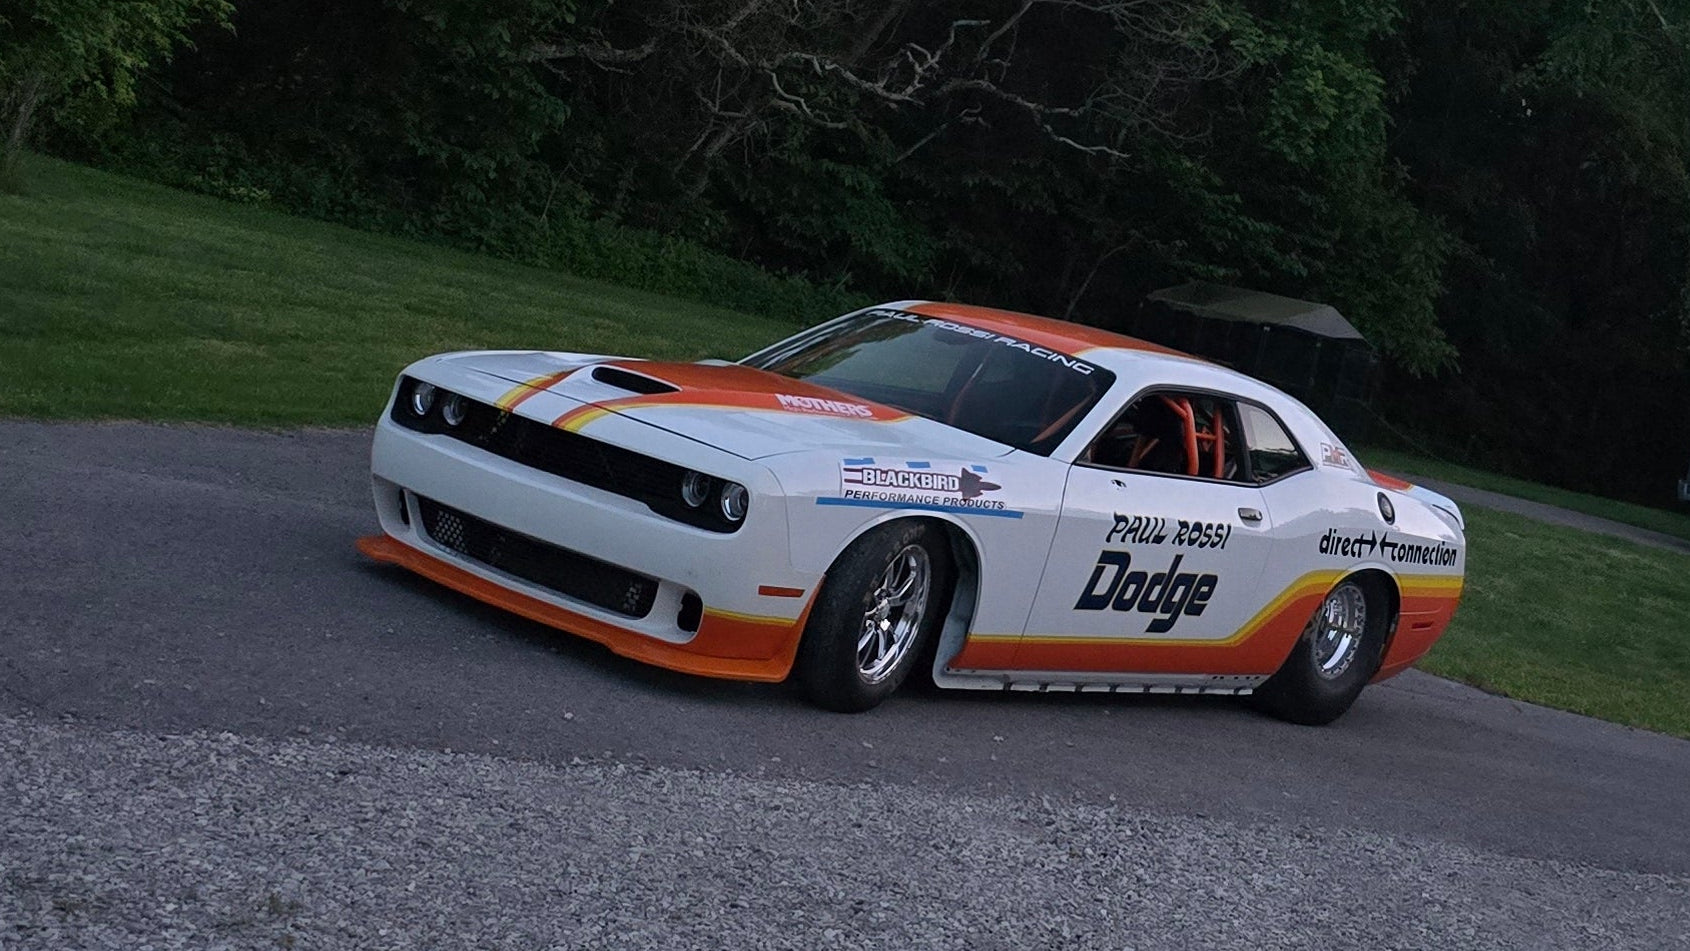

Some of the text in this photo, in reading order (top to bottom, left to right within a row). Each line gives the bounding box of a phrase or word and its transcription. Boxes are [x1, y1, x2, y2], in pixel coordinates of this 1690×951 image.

[866, 309, 1095, 375] PAUL ROSSI RACING
[774, 393, 873, 417] MOTHERS
[861, 468, 960, 491] BLACKBIRD
[844, 489, 1005, 510] PERFORMANCE PRODUCTS
[1105, 511, 1232, 549] PAUL ROSSI
[1319, 528, 1457, 567] direct connection
[1073, 549, 1219, 633] Dodge
